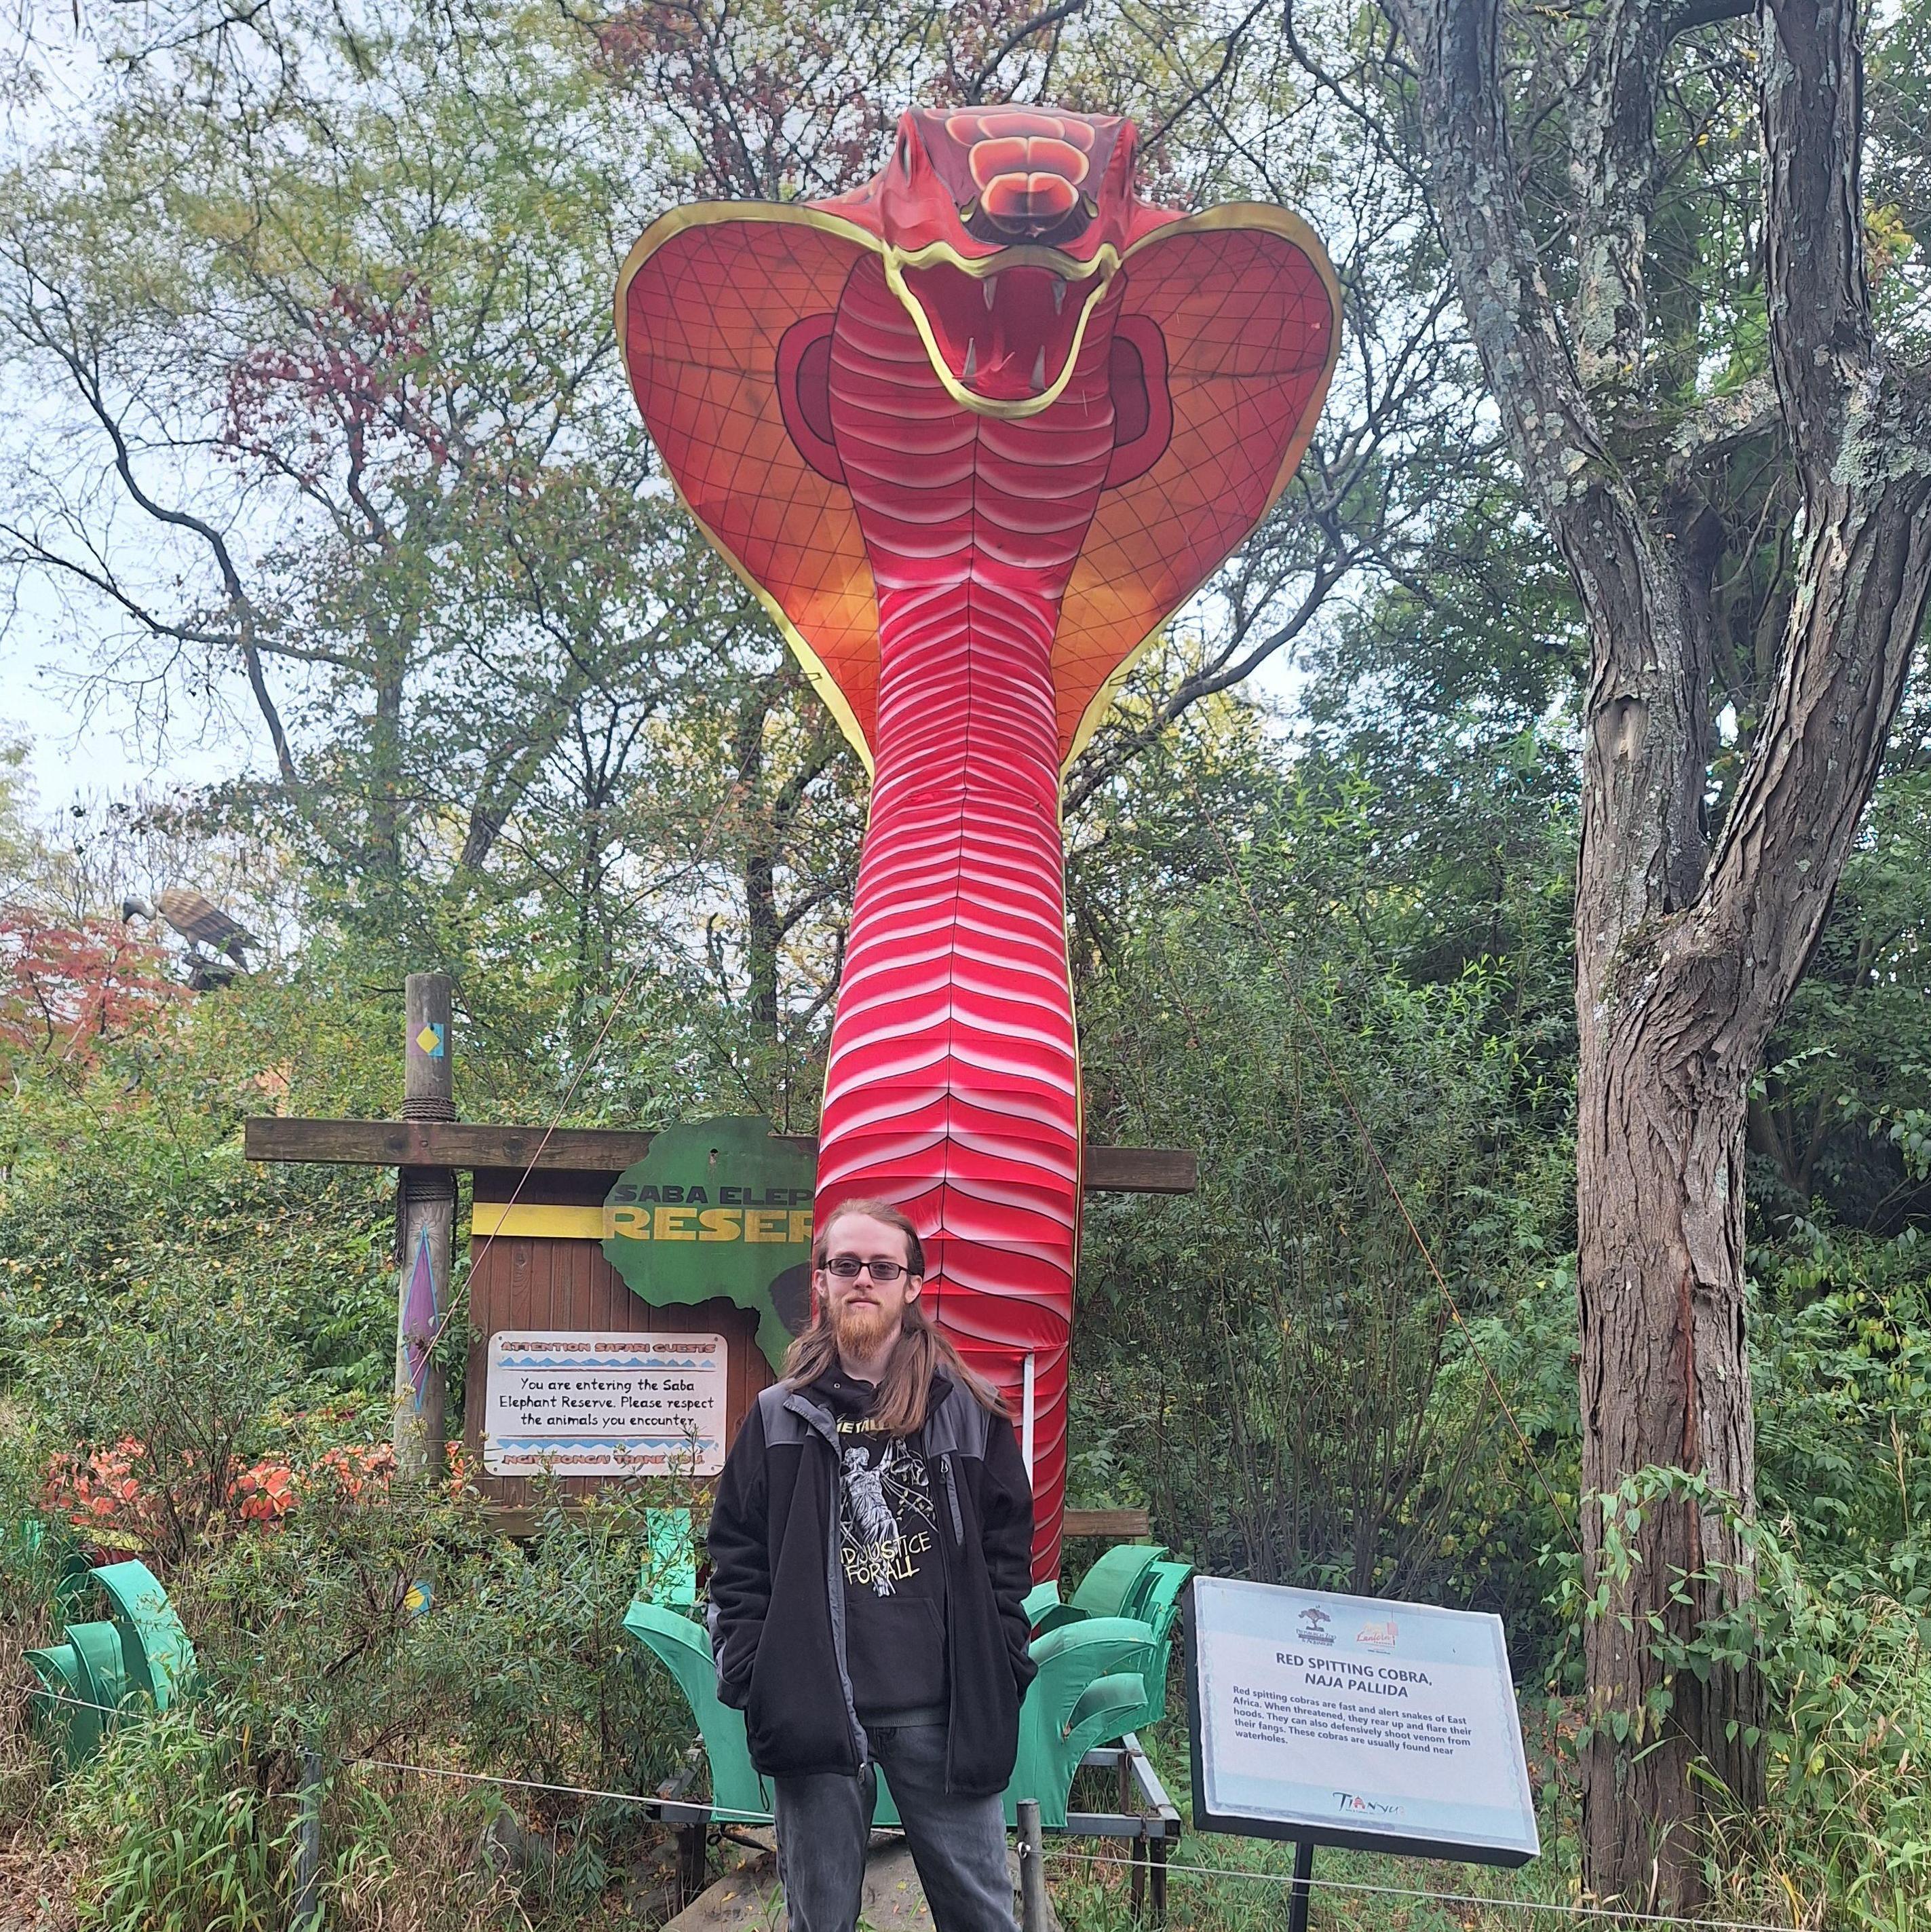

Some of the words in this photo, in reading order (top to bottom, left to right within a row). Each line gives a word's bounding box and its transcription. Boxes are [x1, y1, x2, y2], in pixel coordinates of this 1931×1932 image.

[615, 1184, 708, 1204] SABA
[501, 1341, 591, 1352] ATTENTION
[594, 1343, 650, 1353] SAFARI
[652, 1343, 716, 1353] GUESTS
[521, 1378, 543, 1390] You
[576, 1378, 632, 1393] entering
[638, 1379, 658, 1390] the
[663, 1379, 695, 1391] Saba
[499, 1395, 557, 1411] Elephant
[562, 1396, 616, 1408] Reserve.
[621, 1396, 662, 1408] Please
[667, 1397, 714, 1412] respect
[521, 1413, 542, 1425] the
[547, 1414, 598, 1426] animals
[603, 1417, 625, 1428] you
[614, 1455, 666, 1464] THANK
[860, 1531, 932, 1564] JUSTICE
[846, 1562, 881, 1585] FOR
[886, 1555, 920, 1580] ALL
[1276, 1652, 1304, 1667] RED
[1308, 1657, 1374, 1677] SPITTING
[1378, 1667, 1432, 1686] COBRA,
[1305, 1673, 1343, 1688] NAJA
[1348, 1680, 1408, 1697] PALLIDA
[1233, 1686, 1250, 1695] Red
[1253, 1690, 1287, 1703] spitting
[1290, 1696, 1320, 1706] cobras
[1339, 1702, 1356, 1711] fast
[1358, 1706, 1376, 1714] and
[1378, 1708, 1399, 1718] alert
[1402, 1711, 1432, 1722] snakes
[1448, 1716, 1467, 1724] East
[1233, 1697, 1262, 1708] Africa.
[1264, 1701, 1291, 1713] When
[1293, 1706, 1345, 1722] threatened,
[1348, 1714, 1369, 1726] they
[1371, 1718, 1390, 1726] rear
[1392, 1721, 1404, 1730] up
[1407, 1722, 1423, 1730] and
[1426, 1724, 1447, 1733] flare
[1449, 1726, 1472, 1735] their
[1234, 1707, 1265, 1720] hoods.
[1267, 1712, 1288, 1724] They
[1291, 1717, 1307, 1725] can
[1309, 1719, 1328, 1728] also
[1331, 1722, 1381, 1738] defensively
[1385, 1730, 1411, 1740] shoot
[1413, 1734, 1445, 1743] venom
[1448, 1736, 1471, 1746] from
[1234, 1718, 1256, 1728] their
[1259, 1721, 1286, 1734] fangs.
[1288, 1726, 1315, 1737] These
[1318, 1731, 1348, 1743] cobras
[1367, 1738, 1400, 1751] usually
[1402, 1741, 1430, 1752] found
[1433, 1747, 1454, 1755] near
[1236, 1730, 1288, 1744] waterholes.
